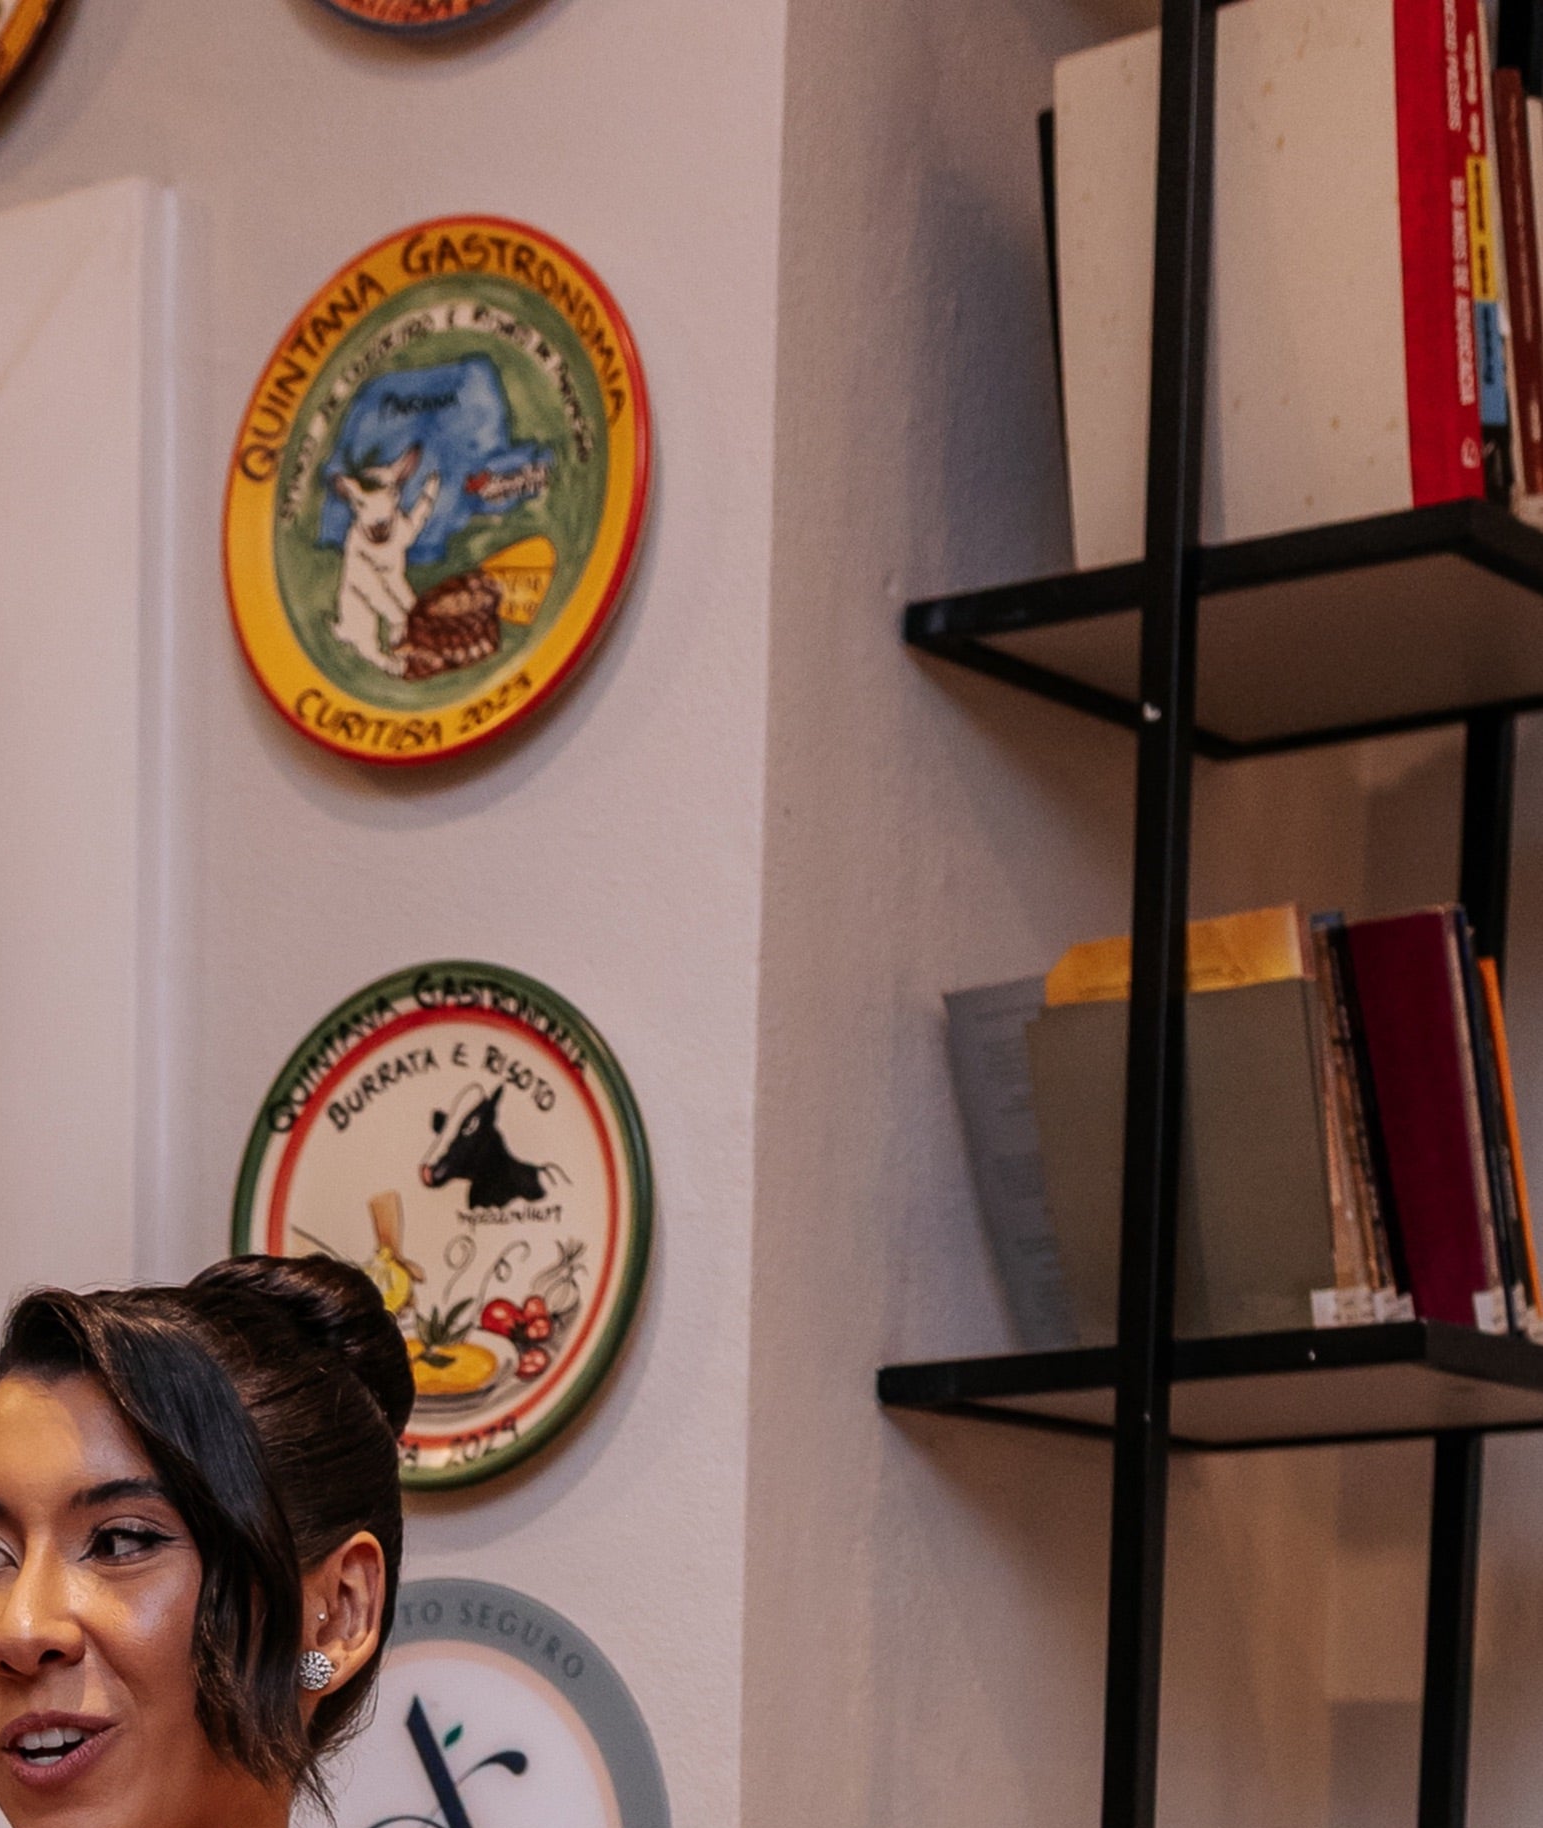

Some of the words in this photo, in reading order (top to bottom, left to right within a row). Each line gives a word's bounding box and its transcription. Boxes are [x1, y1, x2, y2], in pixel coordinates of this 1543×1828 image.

[238, 270, 388, 484] QUINTANA
[401, 230, 628, 429] GASTRONOMIA
[294, 687, 444, 751] CURITIBA
[267, 994, 400, 1134] QUINTANA
[412, 971, 588, 1075] GASTRONOMIA
[326, 1047, 440, 1133] BURRATA
[451, 1042, 469, 1068] E
[482, 1044, 556, 1113] RISOTO
[459, 1598, 585, 1680] SEGURO
